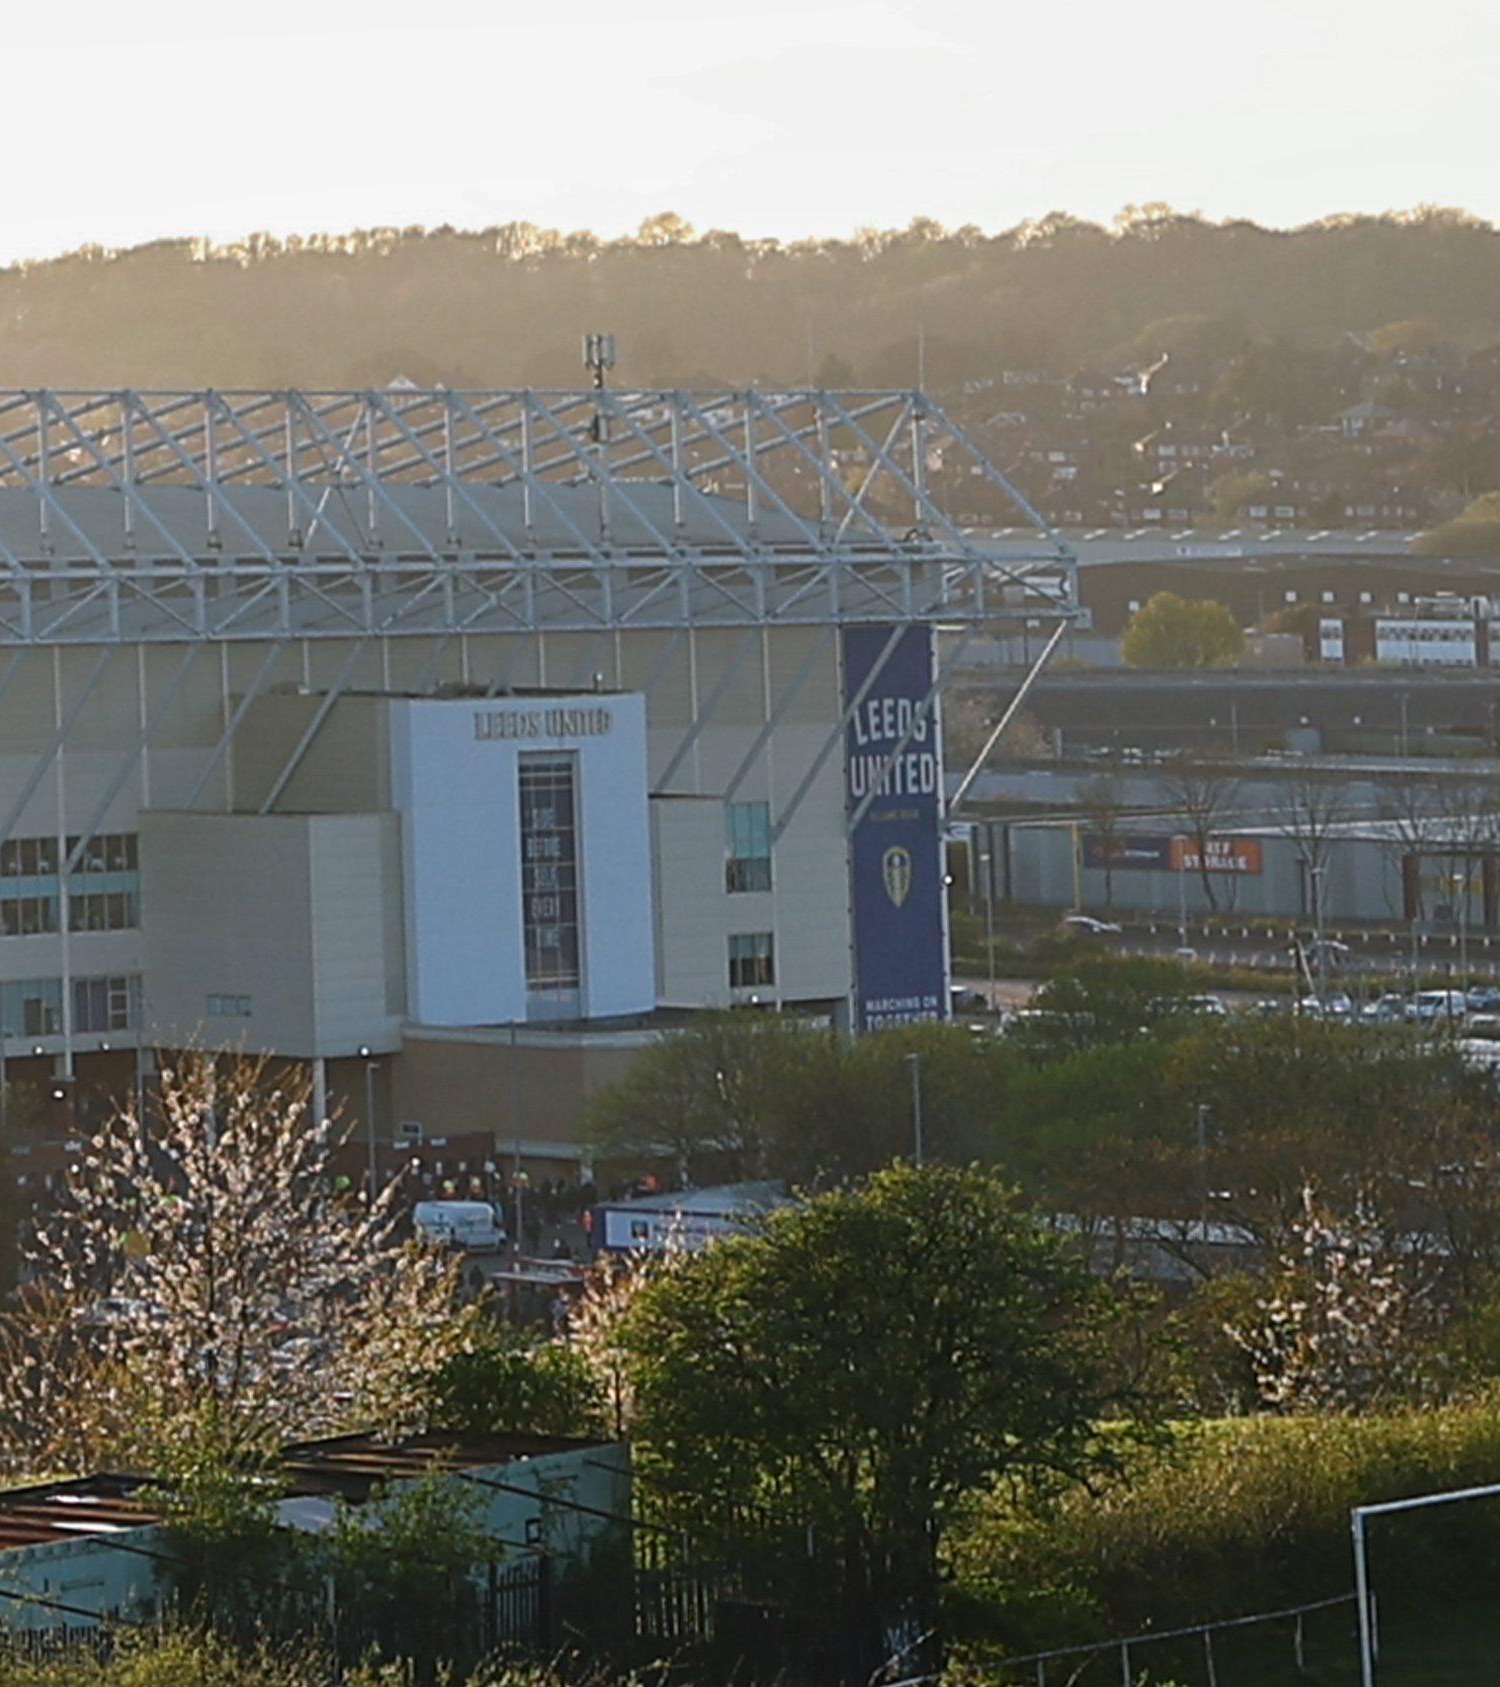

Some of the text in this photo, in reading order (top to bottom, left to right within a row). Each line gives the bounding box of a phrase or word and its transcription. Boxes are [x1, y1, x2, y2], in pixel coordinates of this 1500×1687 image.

[474, 708, 614, 740] LEEDS UNITED
[853, 697, 928, 747] LEEDS
[851, 752, 935, 797] UNITED
